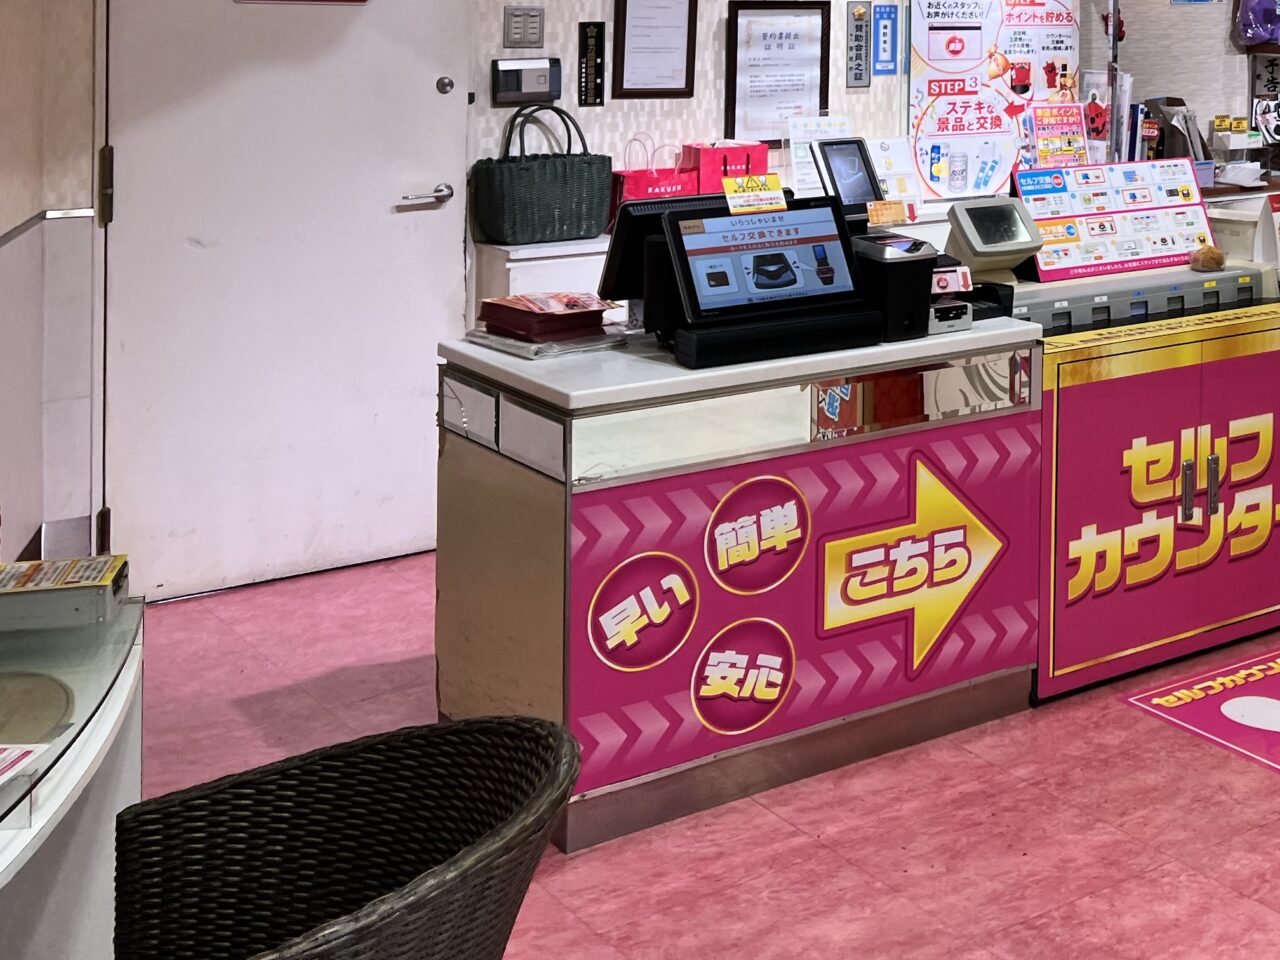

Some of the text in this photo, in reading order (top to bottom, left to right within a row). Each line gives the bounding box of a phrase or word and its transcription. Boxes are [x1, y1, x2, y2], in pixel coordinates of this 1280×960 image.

[1006, 13, 1074, 24] ポイントを貯める
[930, 77, 978, 94] STEP 3
[946, 101, 995, 115] ステキな
[936, 115, 1003, 133] 景品と交換
[731, 216, 784, 227] いらっしゃいませ
[722, 227, 800, 243] セルフ交換できます
[1122, 412, 1274, 502] セルフ
[714, 500, 802, 571] 簡単
[846, 529, 972, 602] こちら
[599, 574, 691, 650] 早い
[700, 651, 785, 701] 安心
